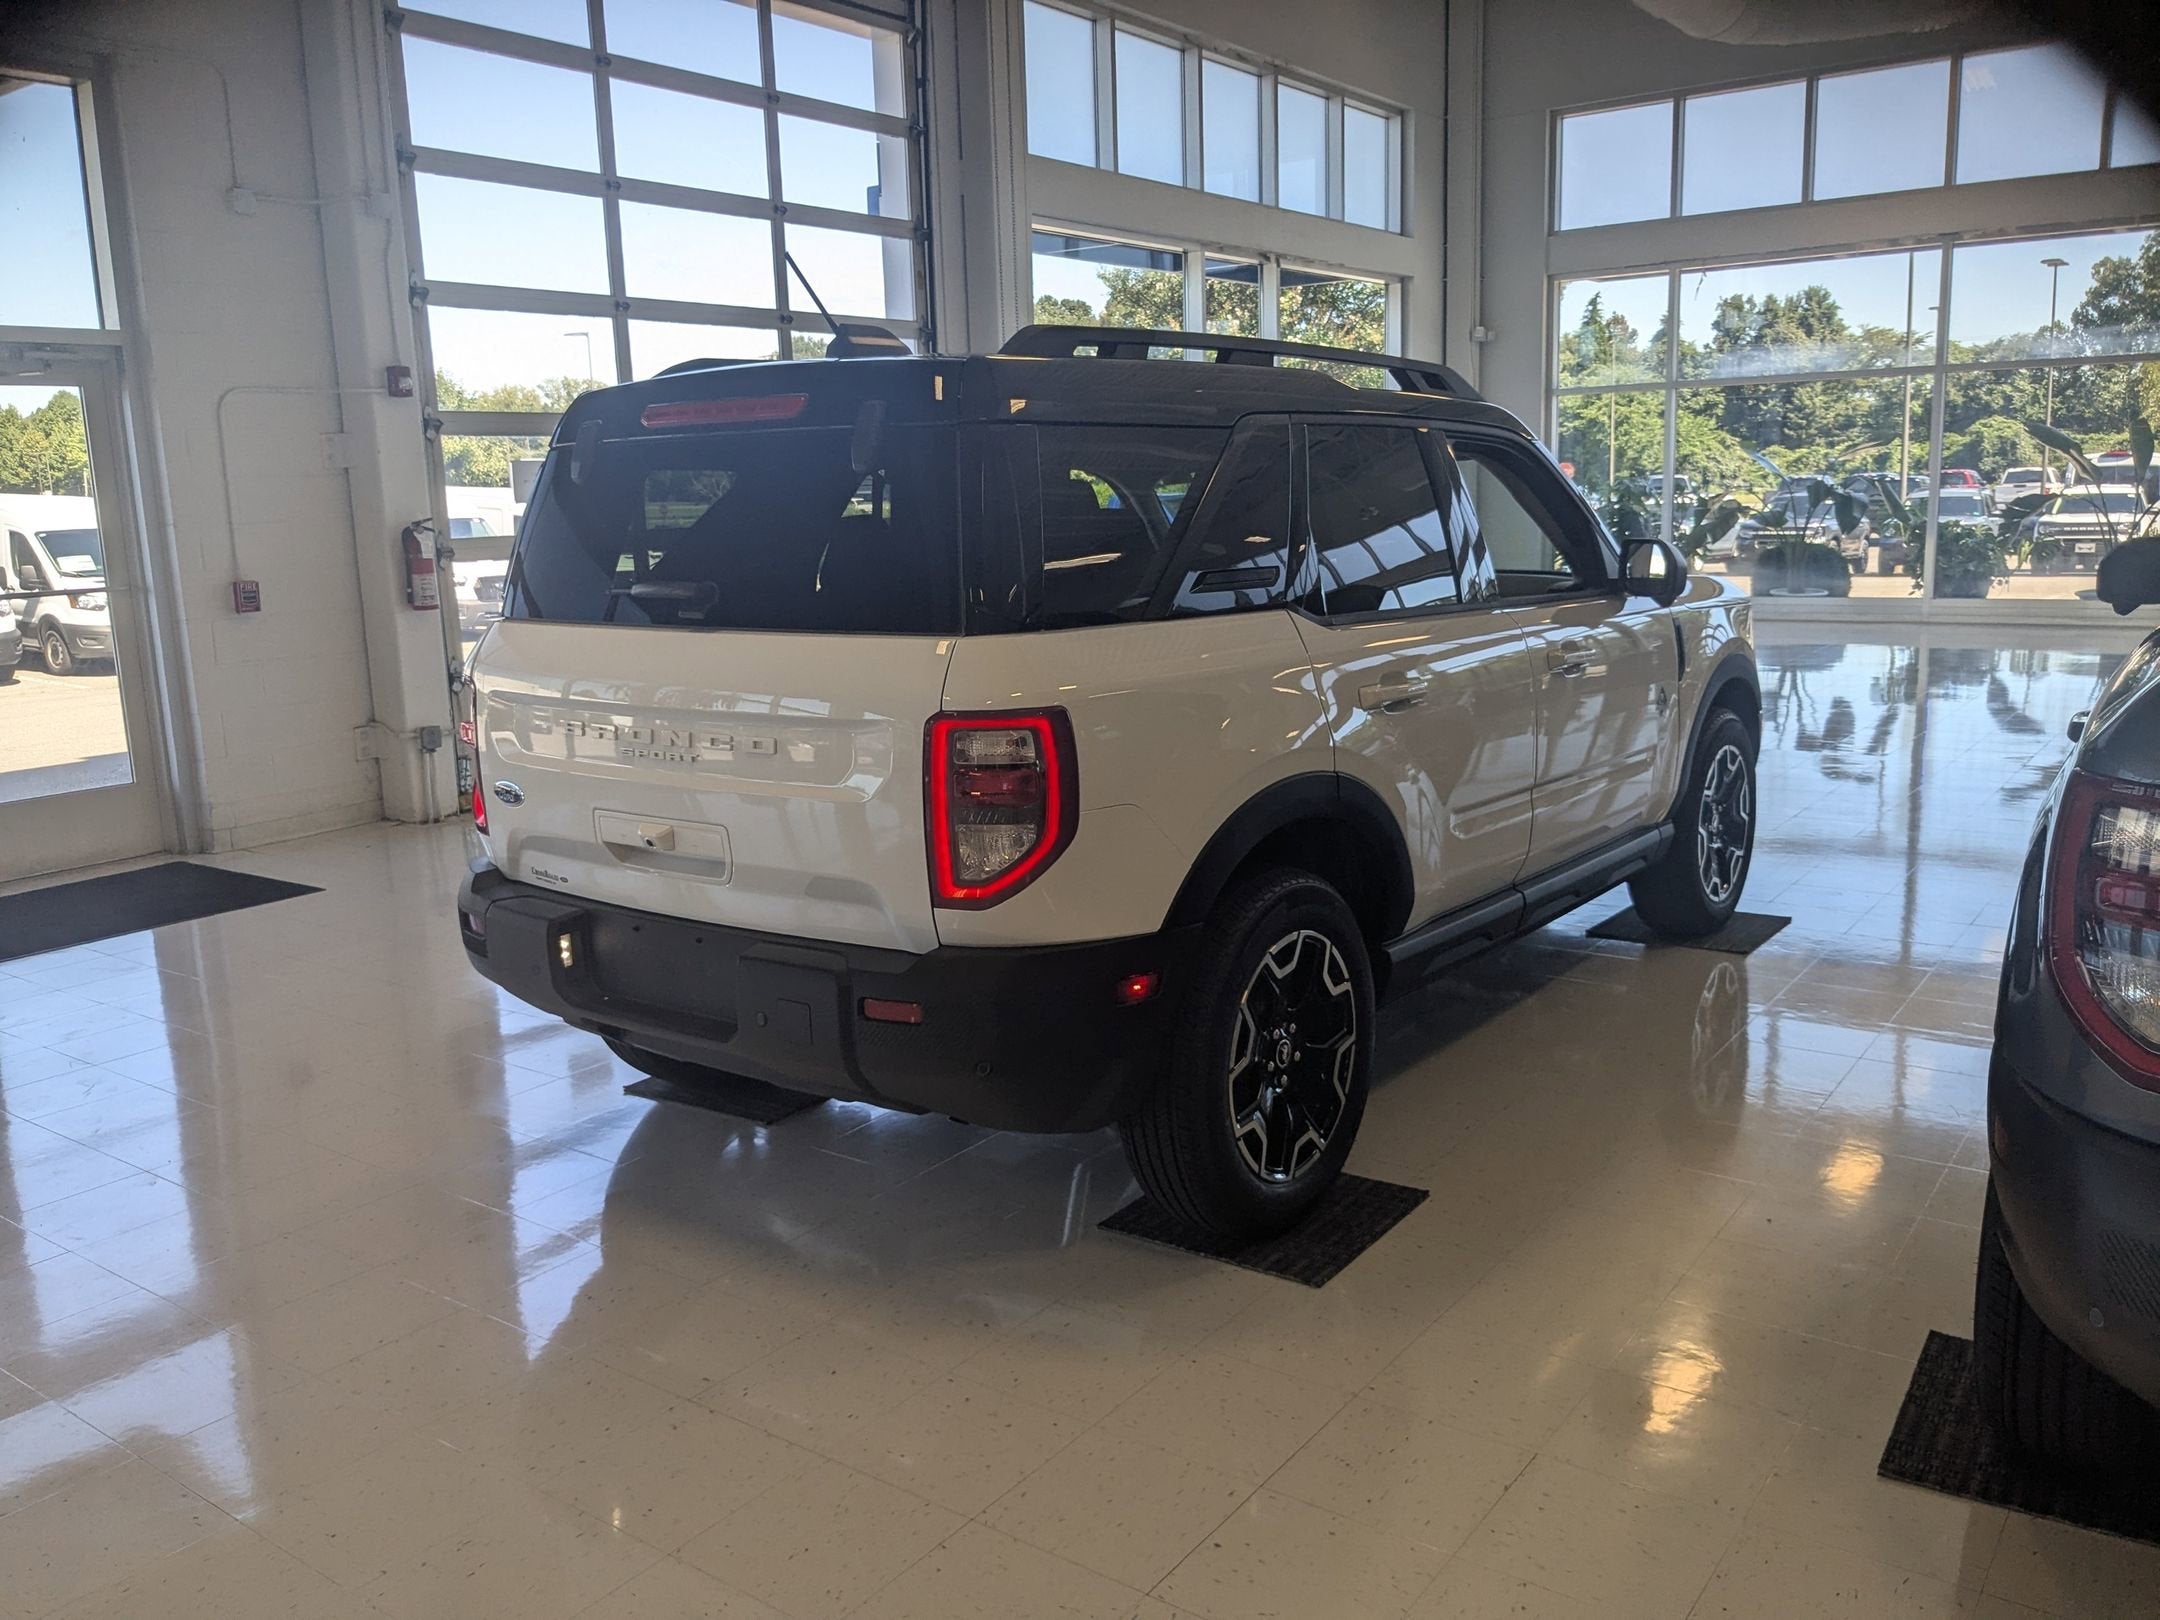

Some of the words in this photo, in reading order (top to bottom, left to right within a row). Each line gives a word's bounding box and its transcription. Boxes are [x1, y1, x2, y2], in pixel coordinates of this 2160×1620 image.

[240, 583, 257, 591] FIRE
[561, 720, 778, 755] BRONCO
[621, 748, 700, 763] SPORT
